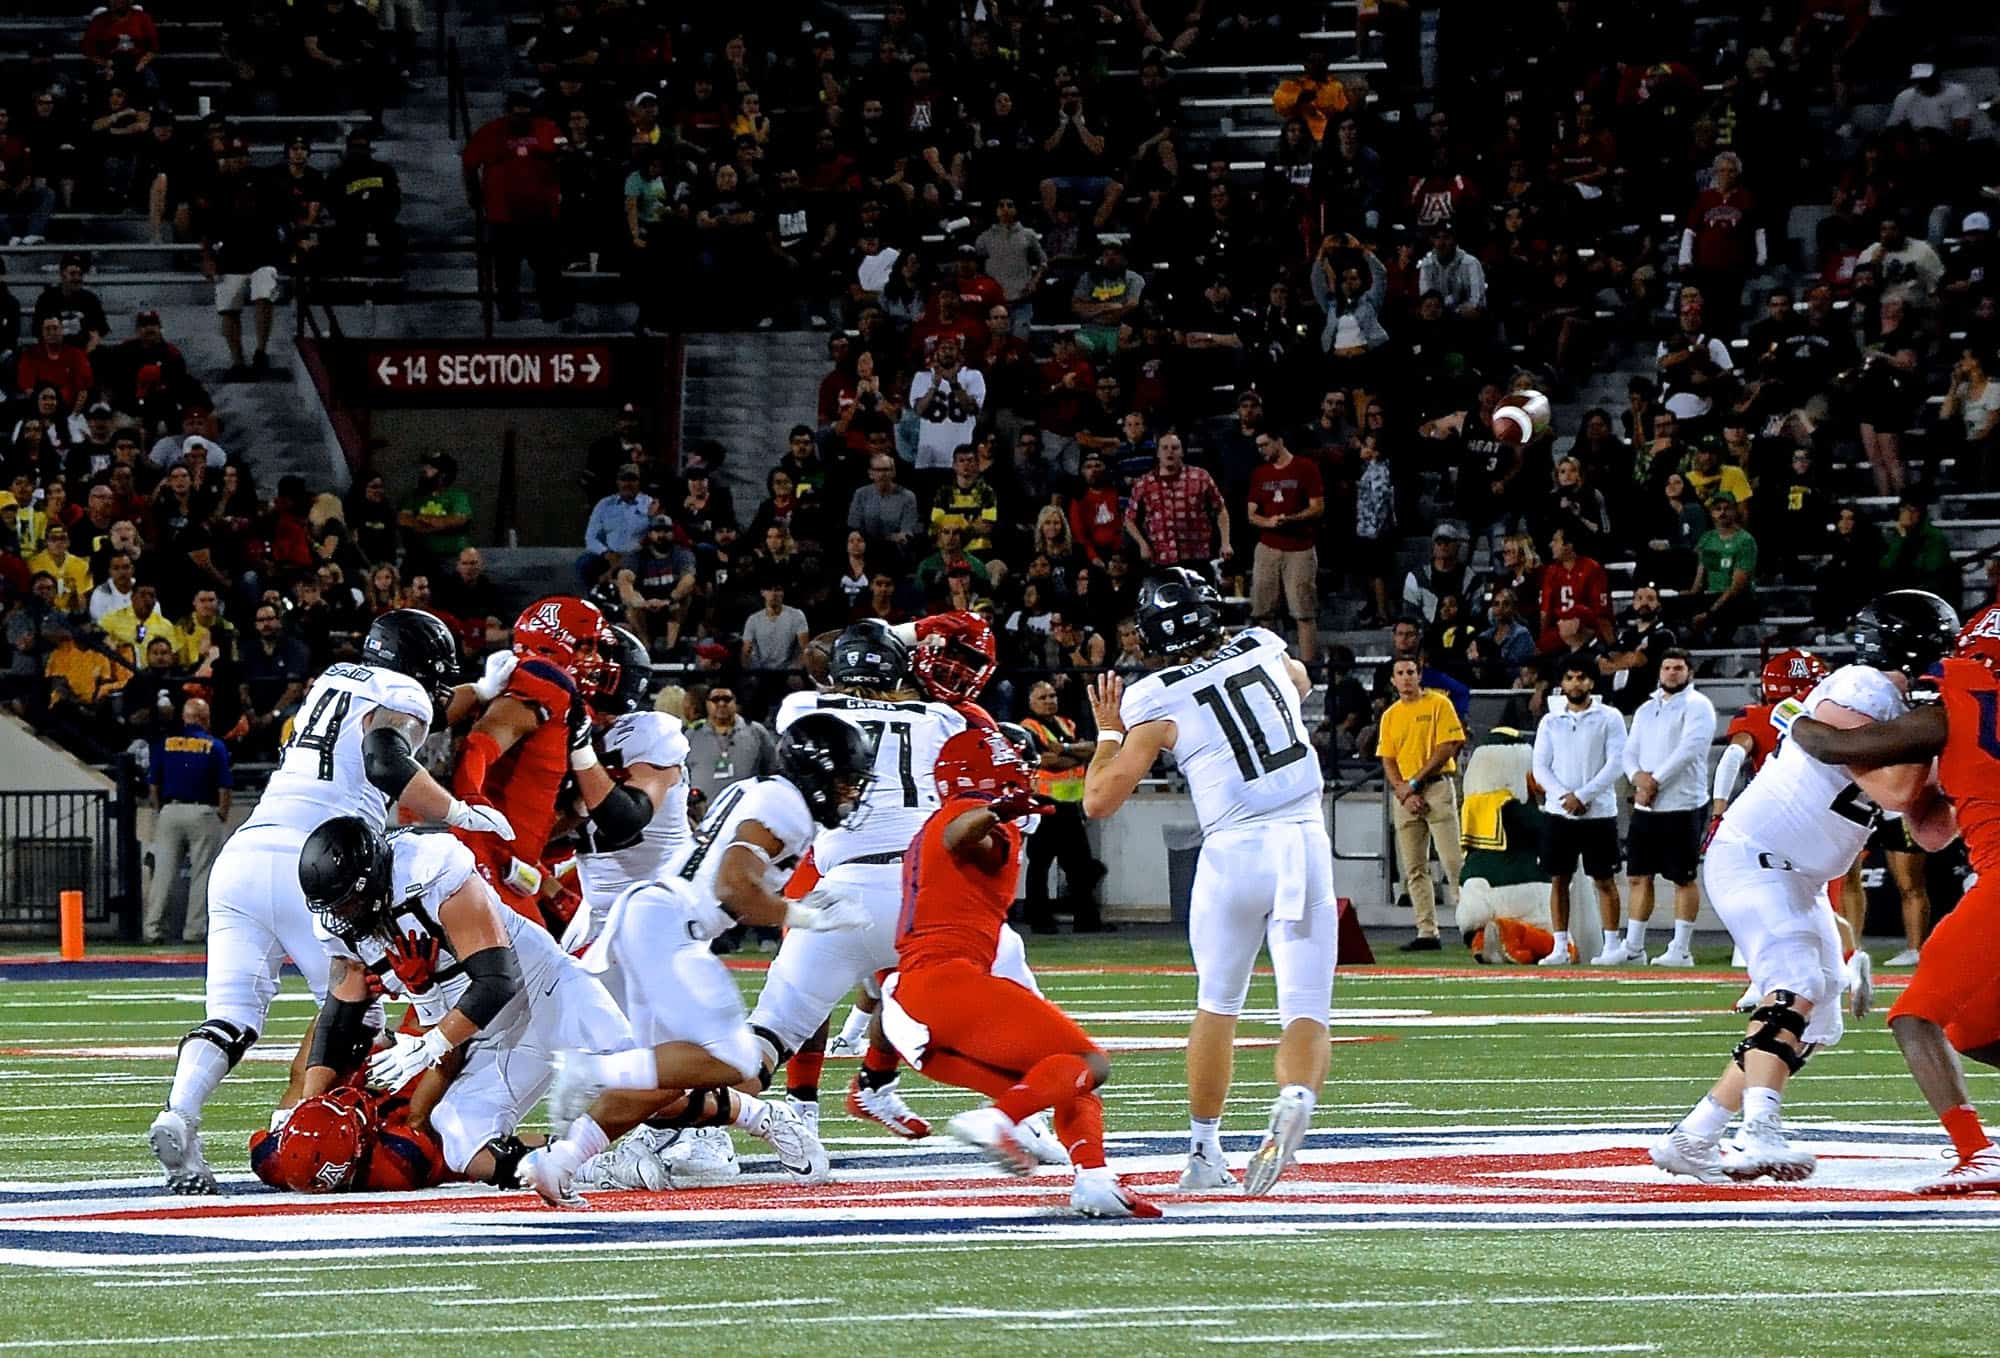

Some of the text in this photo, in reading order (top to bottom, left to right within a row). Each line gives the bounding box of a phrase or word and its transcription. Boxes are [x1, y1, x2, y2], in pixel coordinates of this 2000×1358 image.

[1417, 191, 1452, 225] A
[402, 353, 575, 386] 14 SECTION 15
[1486, 457, 1498, 471] 3
[529, 603, 562, 631] A
[841, 675, 881, 684] DUCKS
[1789, 657, 1811, 679] A
[1192, 664, 1307, 783] 10
[315, 1161, 351, 1189] A
